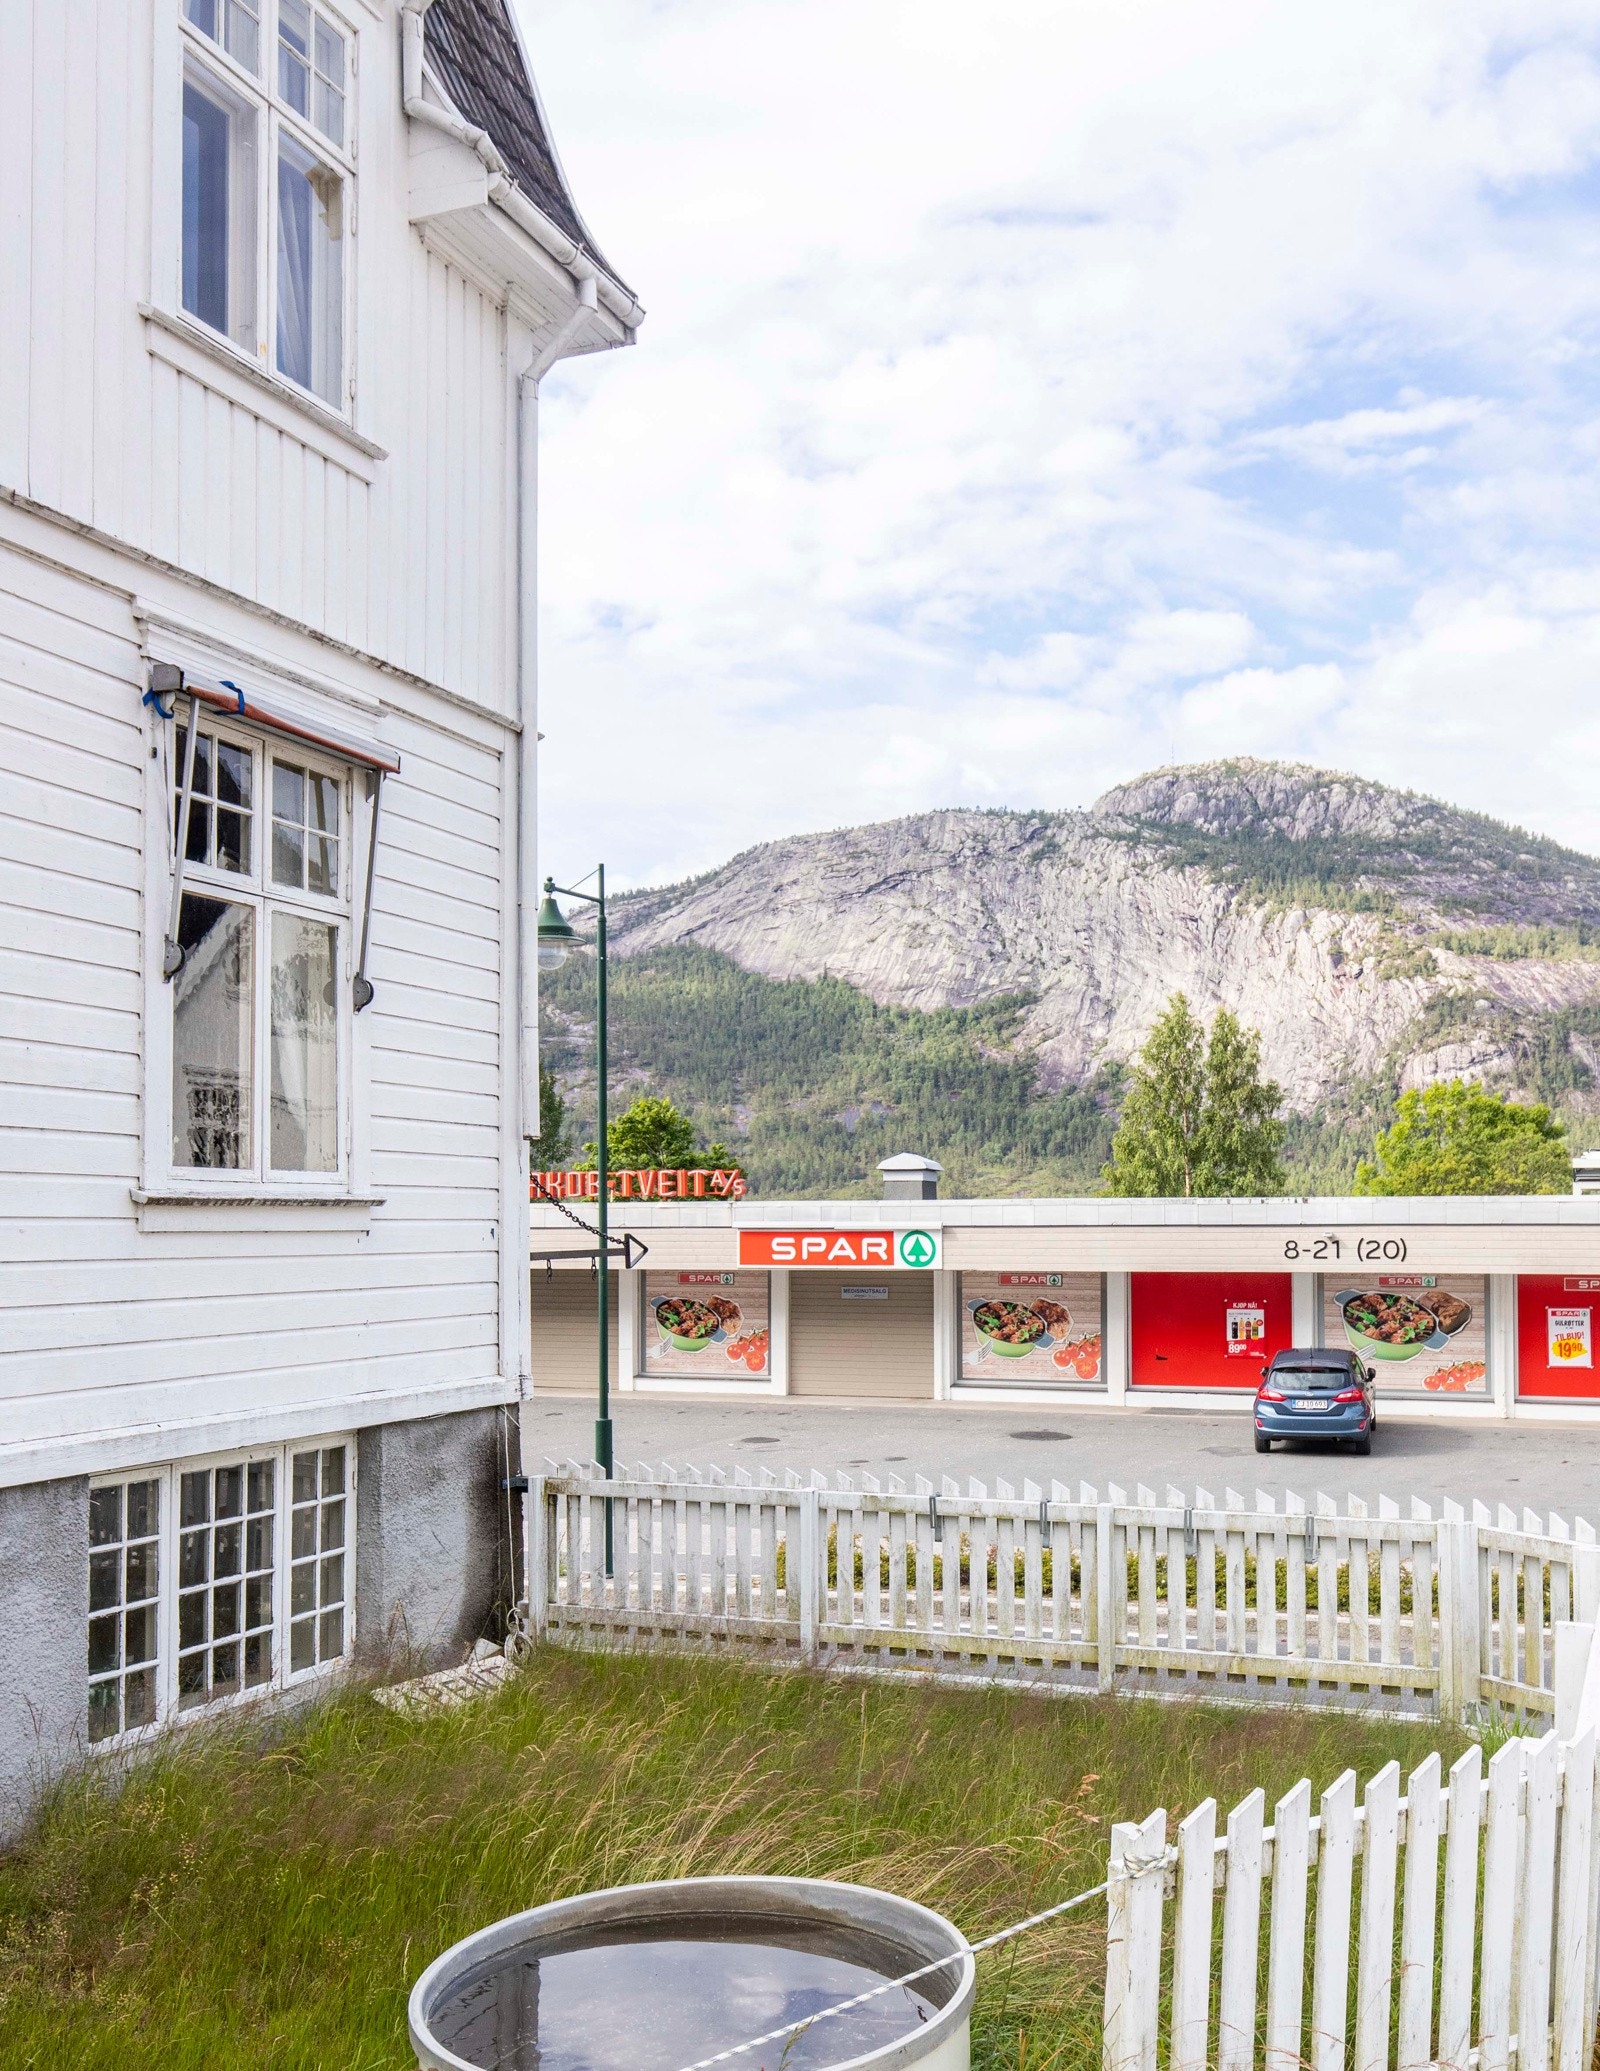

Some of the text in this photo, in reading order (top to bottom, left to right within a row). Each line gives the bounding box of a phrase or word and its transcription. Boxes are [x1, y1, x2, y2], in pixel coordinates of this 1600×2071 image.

[615, 1169, 710, 1197] TVEIT
[710, 1168, 747, 1196] A/S
[771, 1237, 888, 1260] SPAR
[1284, 1237, 1407, 1262] 8-21 (20)
[1010, 1276, 1047, 1284] SPAR
[1388, 1277, 1422, 1285] SPAR
[1555, 1331, 1585, 1341] TILBUD!
